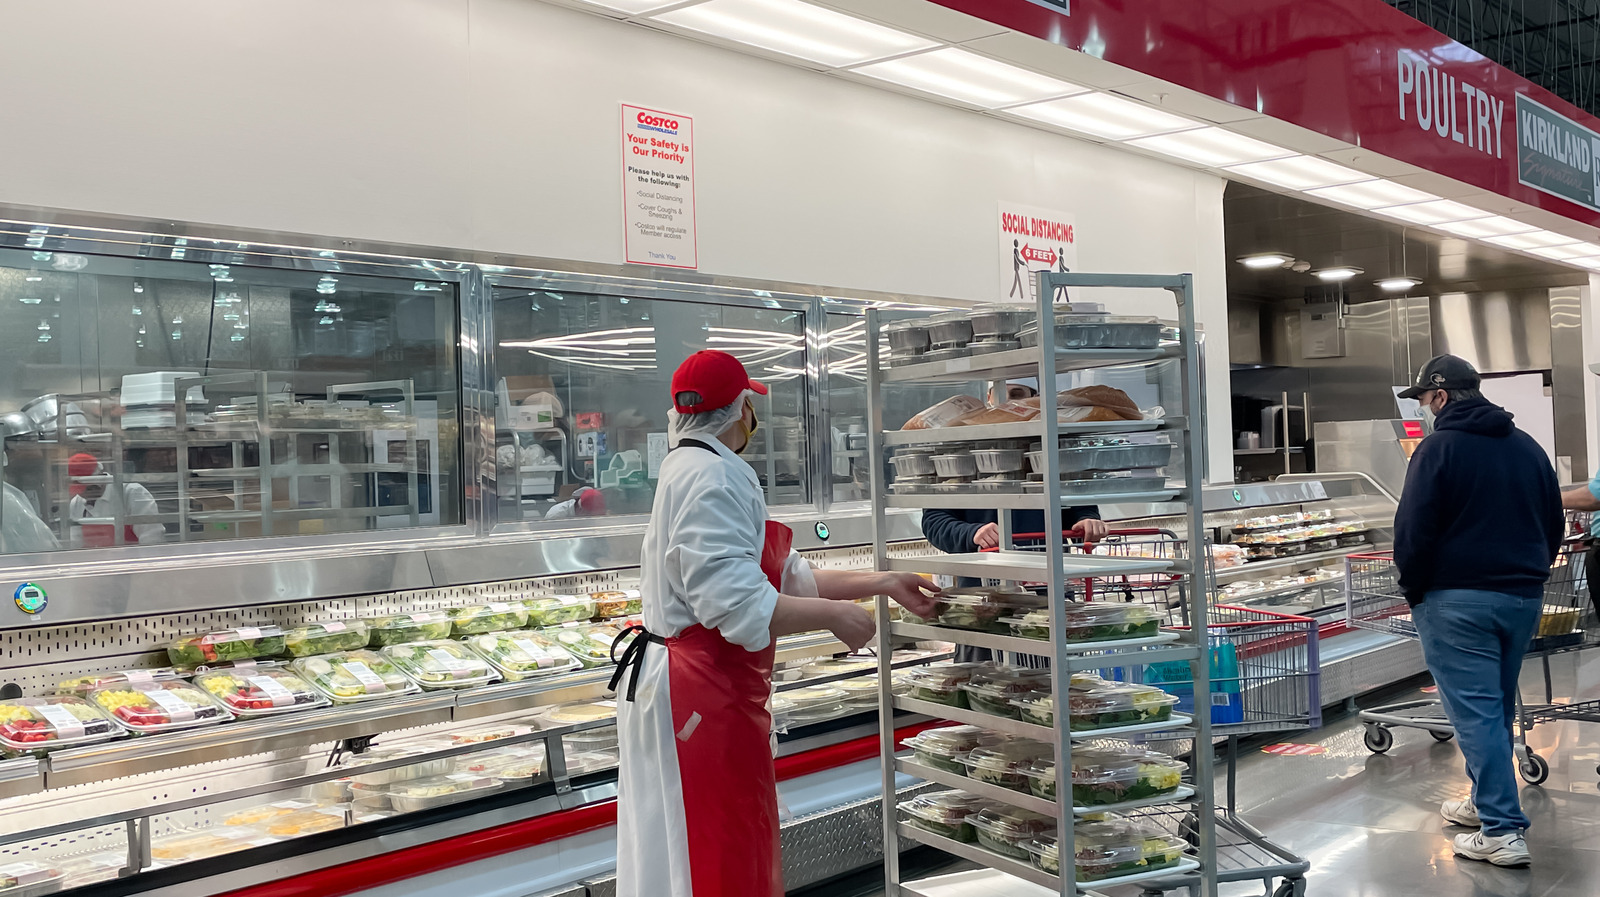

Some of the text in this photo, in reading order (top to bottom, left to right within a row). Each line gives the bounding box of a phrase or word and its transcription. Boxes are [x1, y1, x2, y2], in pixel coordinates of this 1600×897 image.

[1397, 49, 1504, 160] POULTRY
[637, 111, 679, 130] COSTCO
[649, 126, 678, 136] WHOLESALE
[627, 132, 689, 152] Your Safety is
[1521, 109, 1590, 173] KIRKLAND
[632, 145, 685, 164] Our Priority
[628, 166, 650, 175] Please
[651, 170, 665, 178] help
[650, 177, 681, 189] following:
[656, 192, 683, 204] Distancing
[648, 210, 673, 221] Sneezing
[657, 205, 677, 215] Coughs
[666, 226, 687, 234] regulate
[1002, 211, 1074, 244] SOCIAL DISTANCING
[640, 229, 682, 240] Member access
[648, 251, 665, 259] Thank
[1025, 249, 1053, 261] 6 FEET
